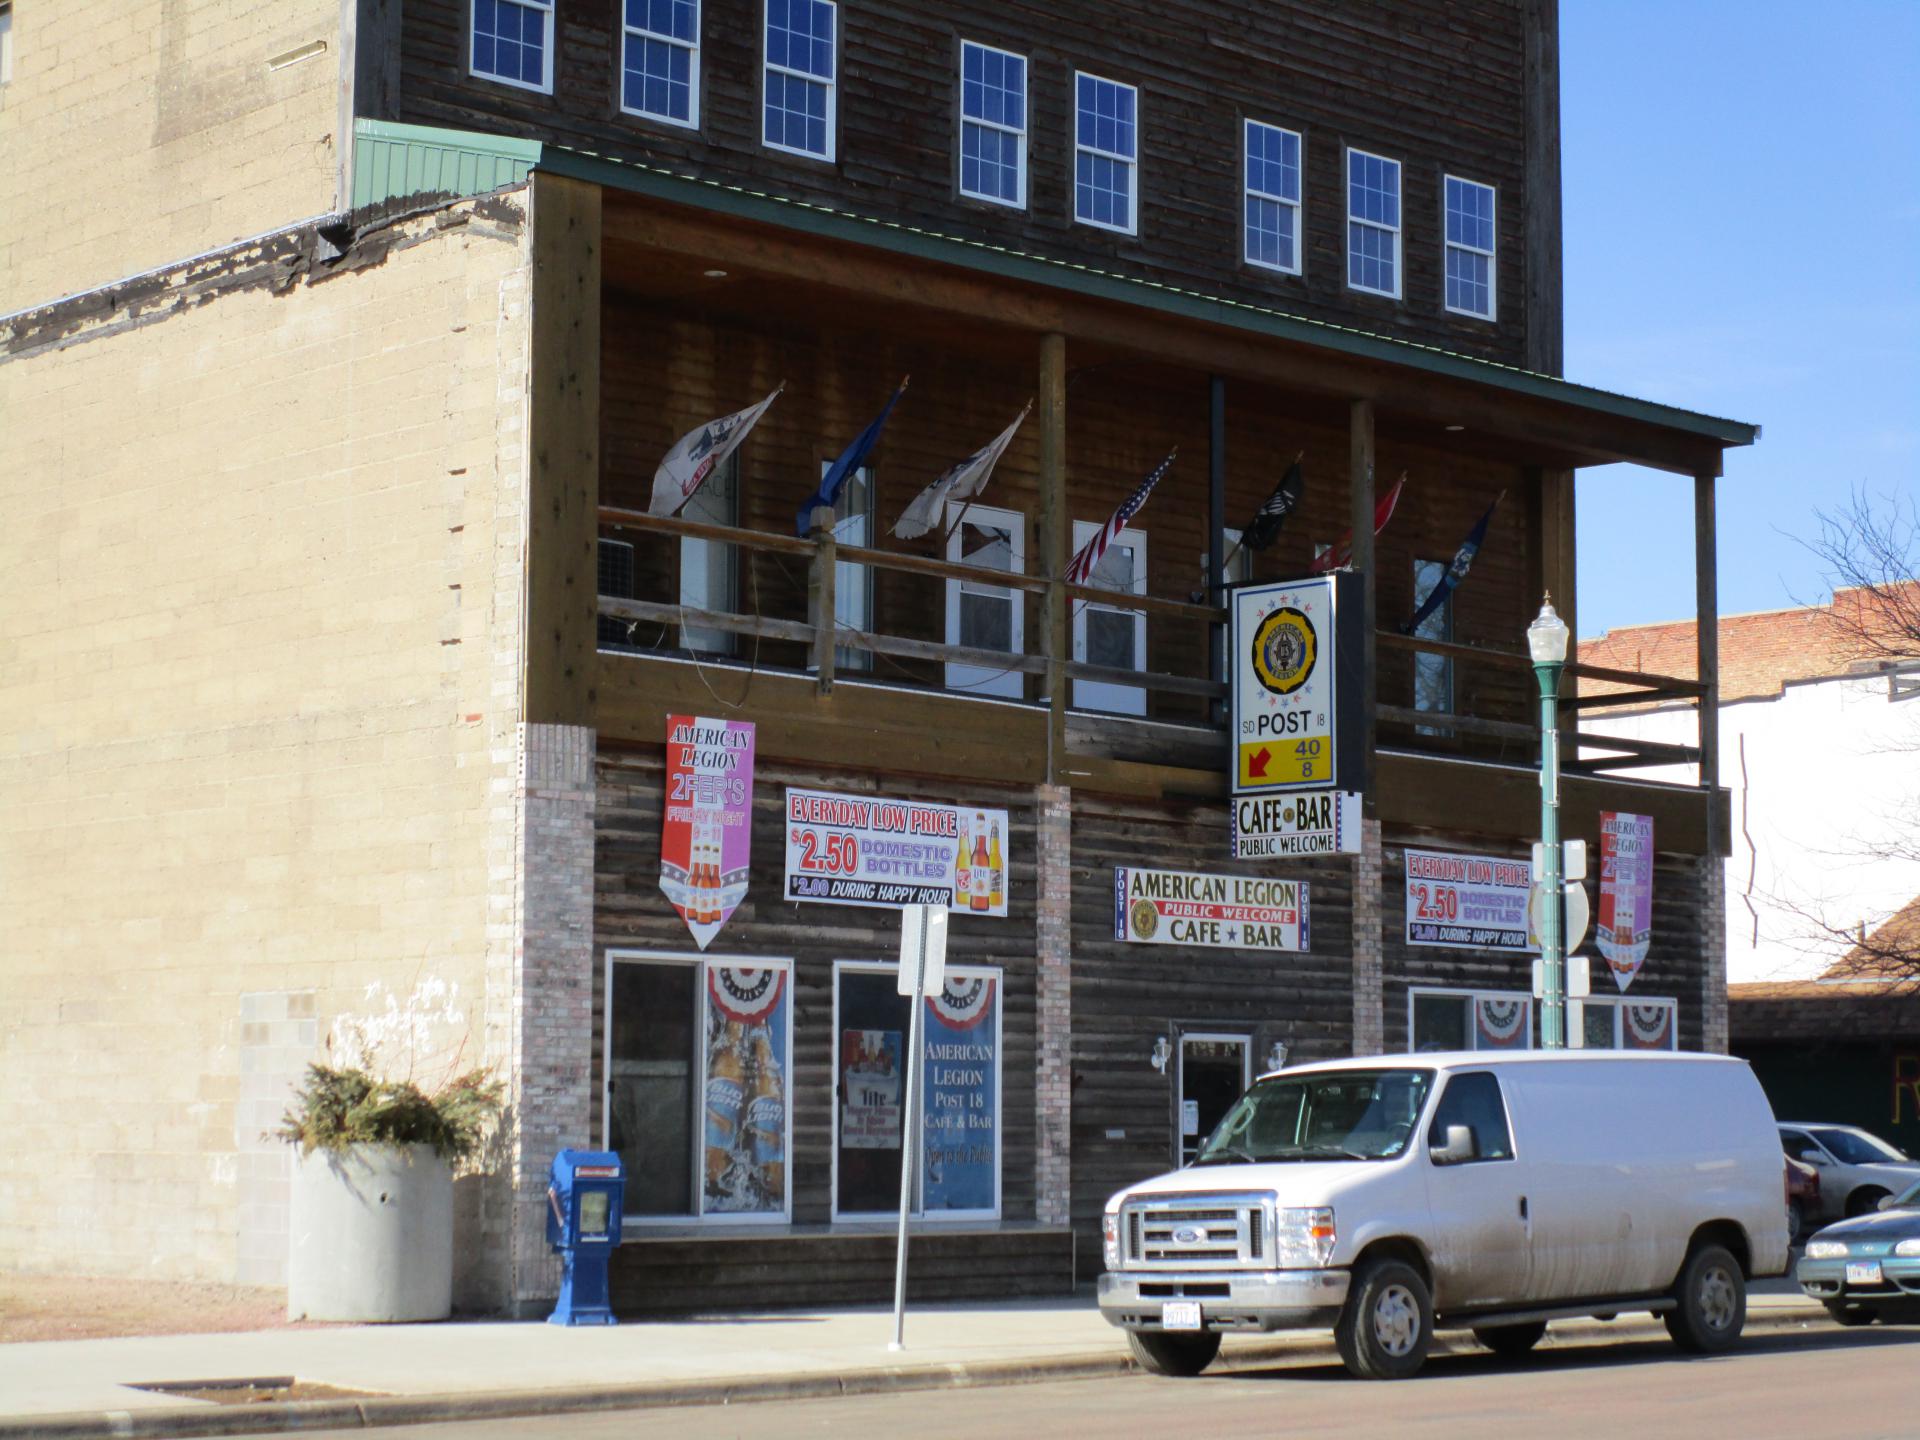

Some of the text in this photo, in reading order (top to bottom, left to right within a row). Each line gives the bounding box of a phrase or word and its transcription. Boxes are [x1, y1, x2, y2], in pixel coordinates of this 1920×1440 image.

[1242, 710, 1325, 737] SD POST 18
[670, 725, 751, 750] AMERICAN
[1295, 739, 1321, 756] 40
[680, 748, 740, 771] LEGION
[1301, 761, 1313, 778] 8
[671, 773, 745, 806] 2FER'S
[668, 806, 709, 824] FRIDAY
[789, 793, 957, 838] EVERYDAY LOW PRICE
[1239, 795, 1332, 835] CAFE BAR
[791, 828, 951, 876] $2.50 DOMESTIC
[1239, 834, 1333, 856] PUBLIC WELCOME
[865, 859, 946, 879] BOTTLES
[1408, 854, 1529, 888] EVERYDAY LOW PRICE
[792, 878, 950, 905] $2.00 DURING HAPPY HOUR
[1131, 872, 1296, 907] AMERICAN LEGION
[1164, 903, 1291, 923] PUBLIC WELCOME
[1410, 883, 1525, 923] $2.50 DOMESTIC
[1464, 906, 1521, 923] BOTTLES
[1170, 919, 1220, 944] CAFE
[1243, 924, 1283, 947] BAR
[1440, 928, 1471, 942] DURING
[1472, 930, 1500, 944] HAPPY
[1501, 932, 1525, 945] HOUR
[925, 1042, 993, 1060] AMERICAN
[934, 1067, 983, 1085] LEGION
[935, 1092, 983, 1108] POST 18
[956, 1114, 966, 1129] &
[969, 1114, 993, 1129] BAR
